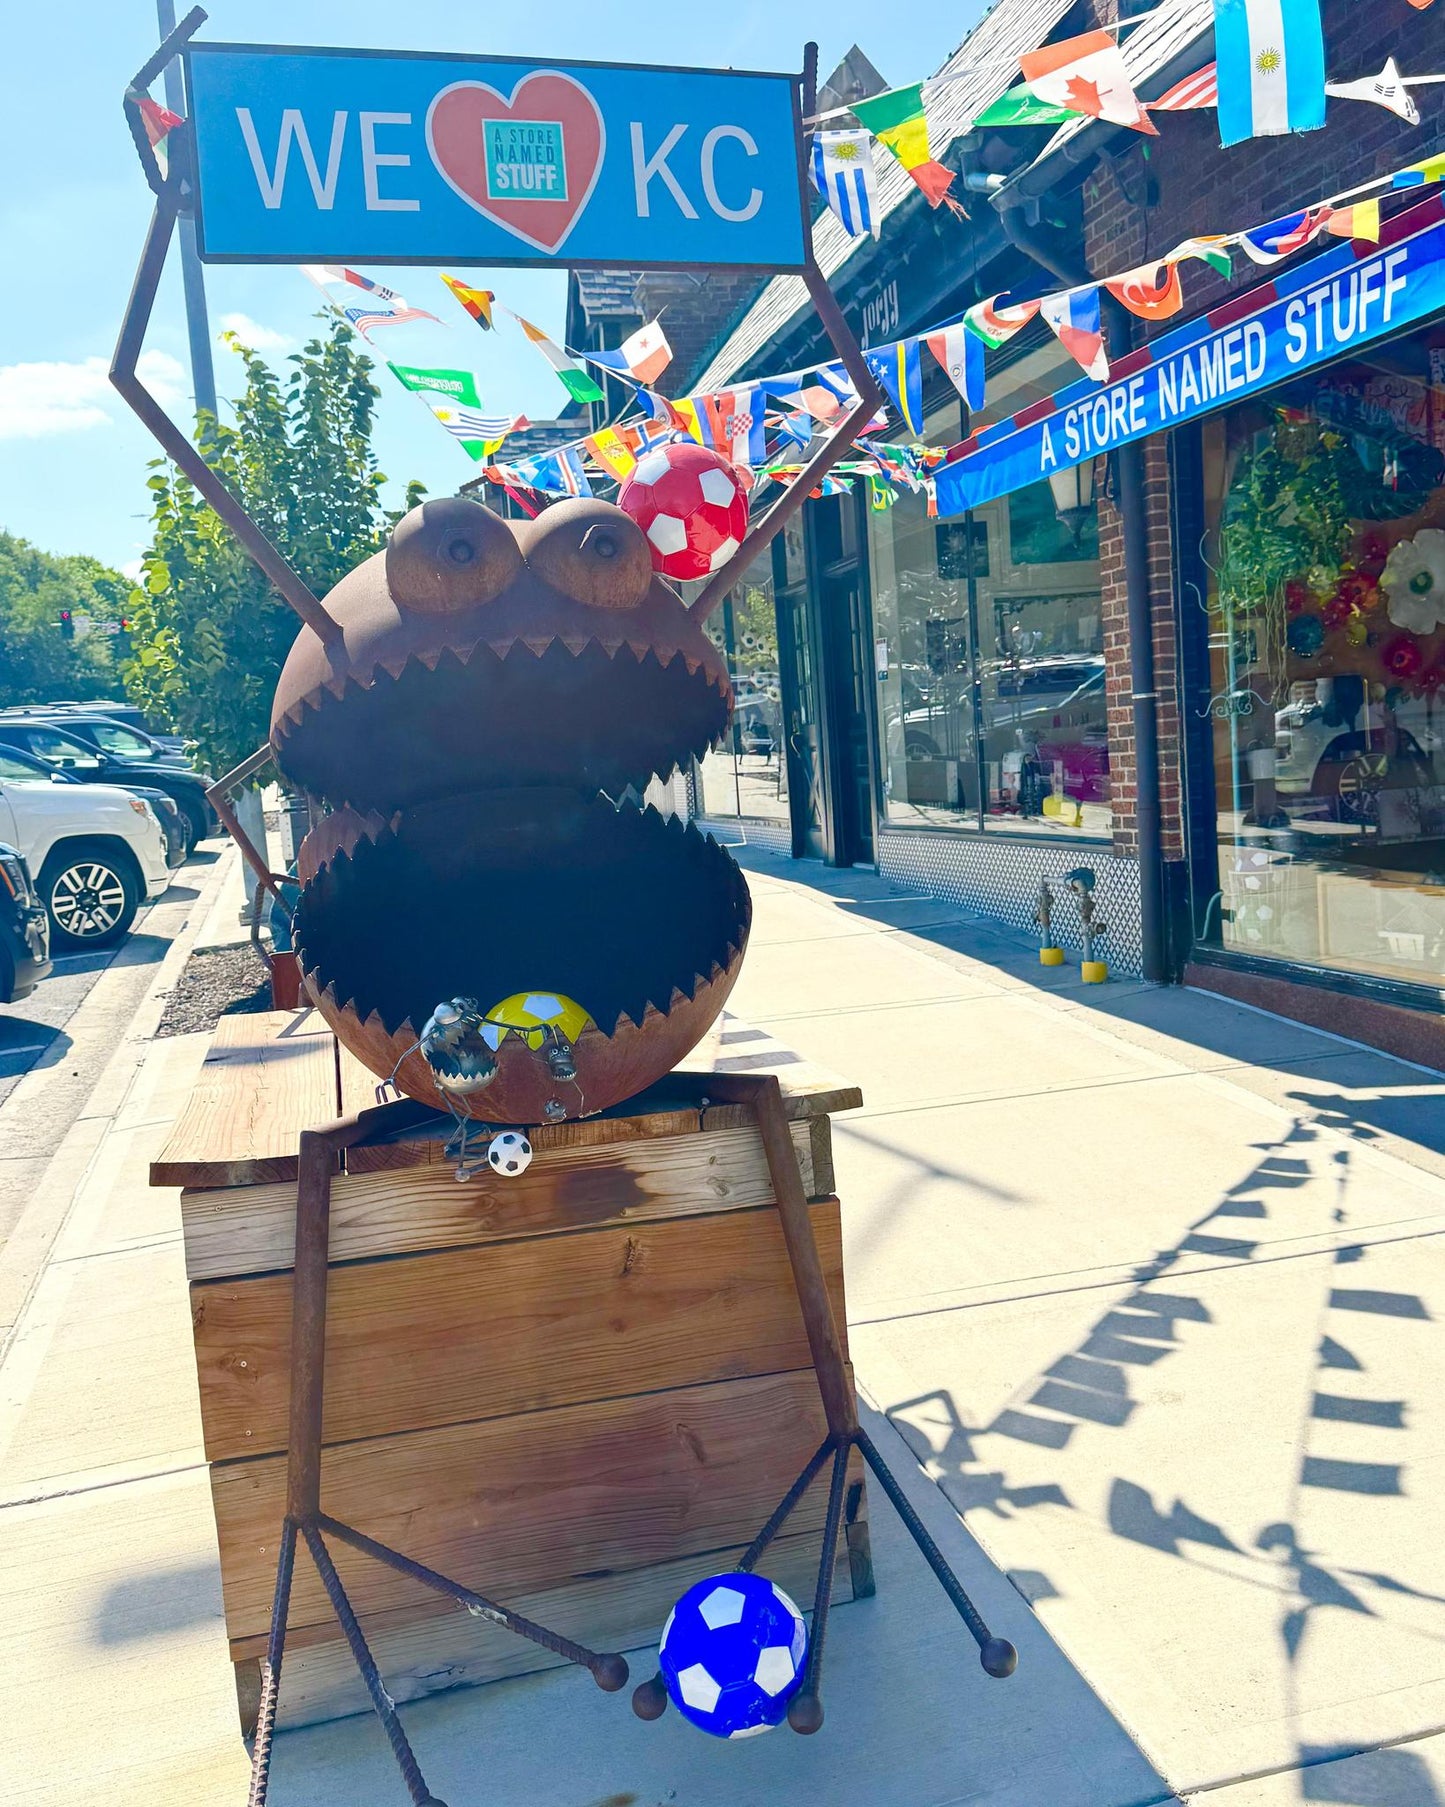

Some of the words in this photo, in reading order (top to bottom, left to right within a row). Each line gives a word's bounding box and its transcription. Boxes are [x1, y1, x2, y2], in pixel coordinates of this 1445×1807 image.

[494, 127, 502, 143] A
[510, 128, 554, 144] STORE
[235, 107, 420, 211] WE
[629, 121, 763, 222] KC
[494, 144, 555, 163] NAMED
[496, 163, 557, 190] STUFF
[1040, 422, 1057, 472] A
[1064, 375, 1148, 459] STORE
[1158, 321, 1267, 421] NAMED
[1284, 248, 1409, 364] STUFF
